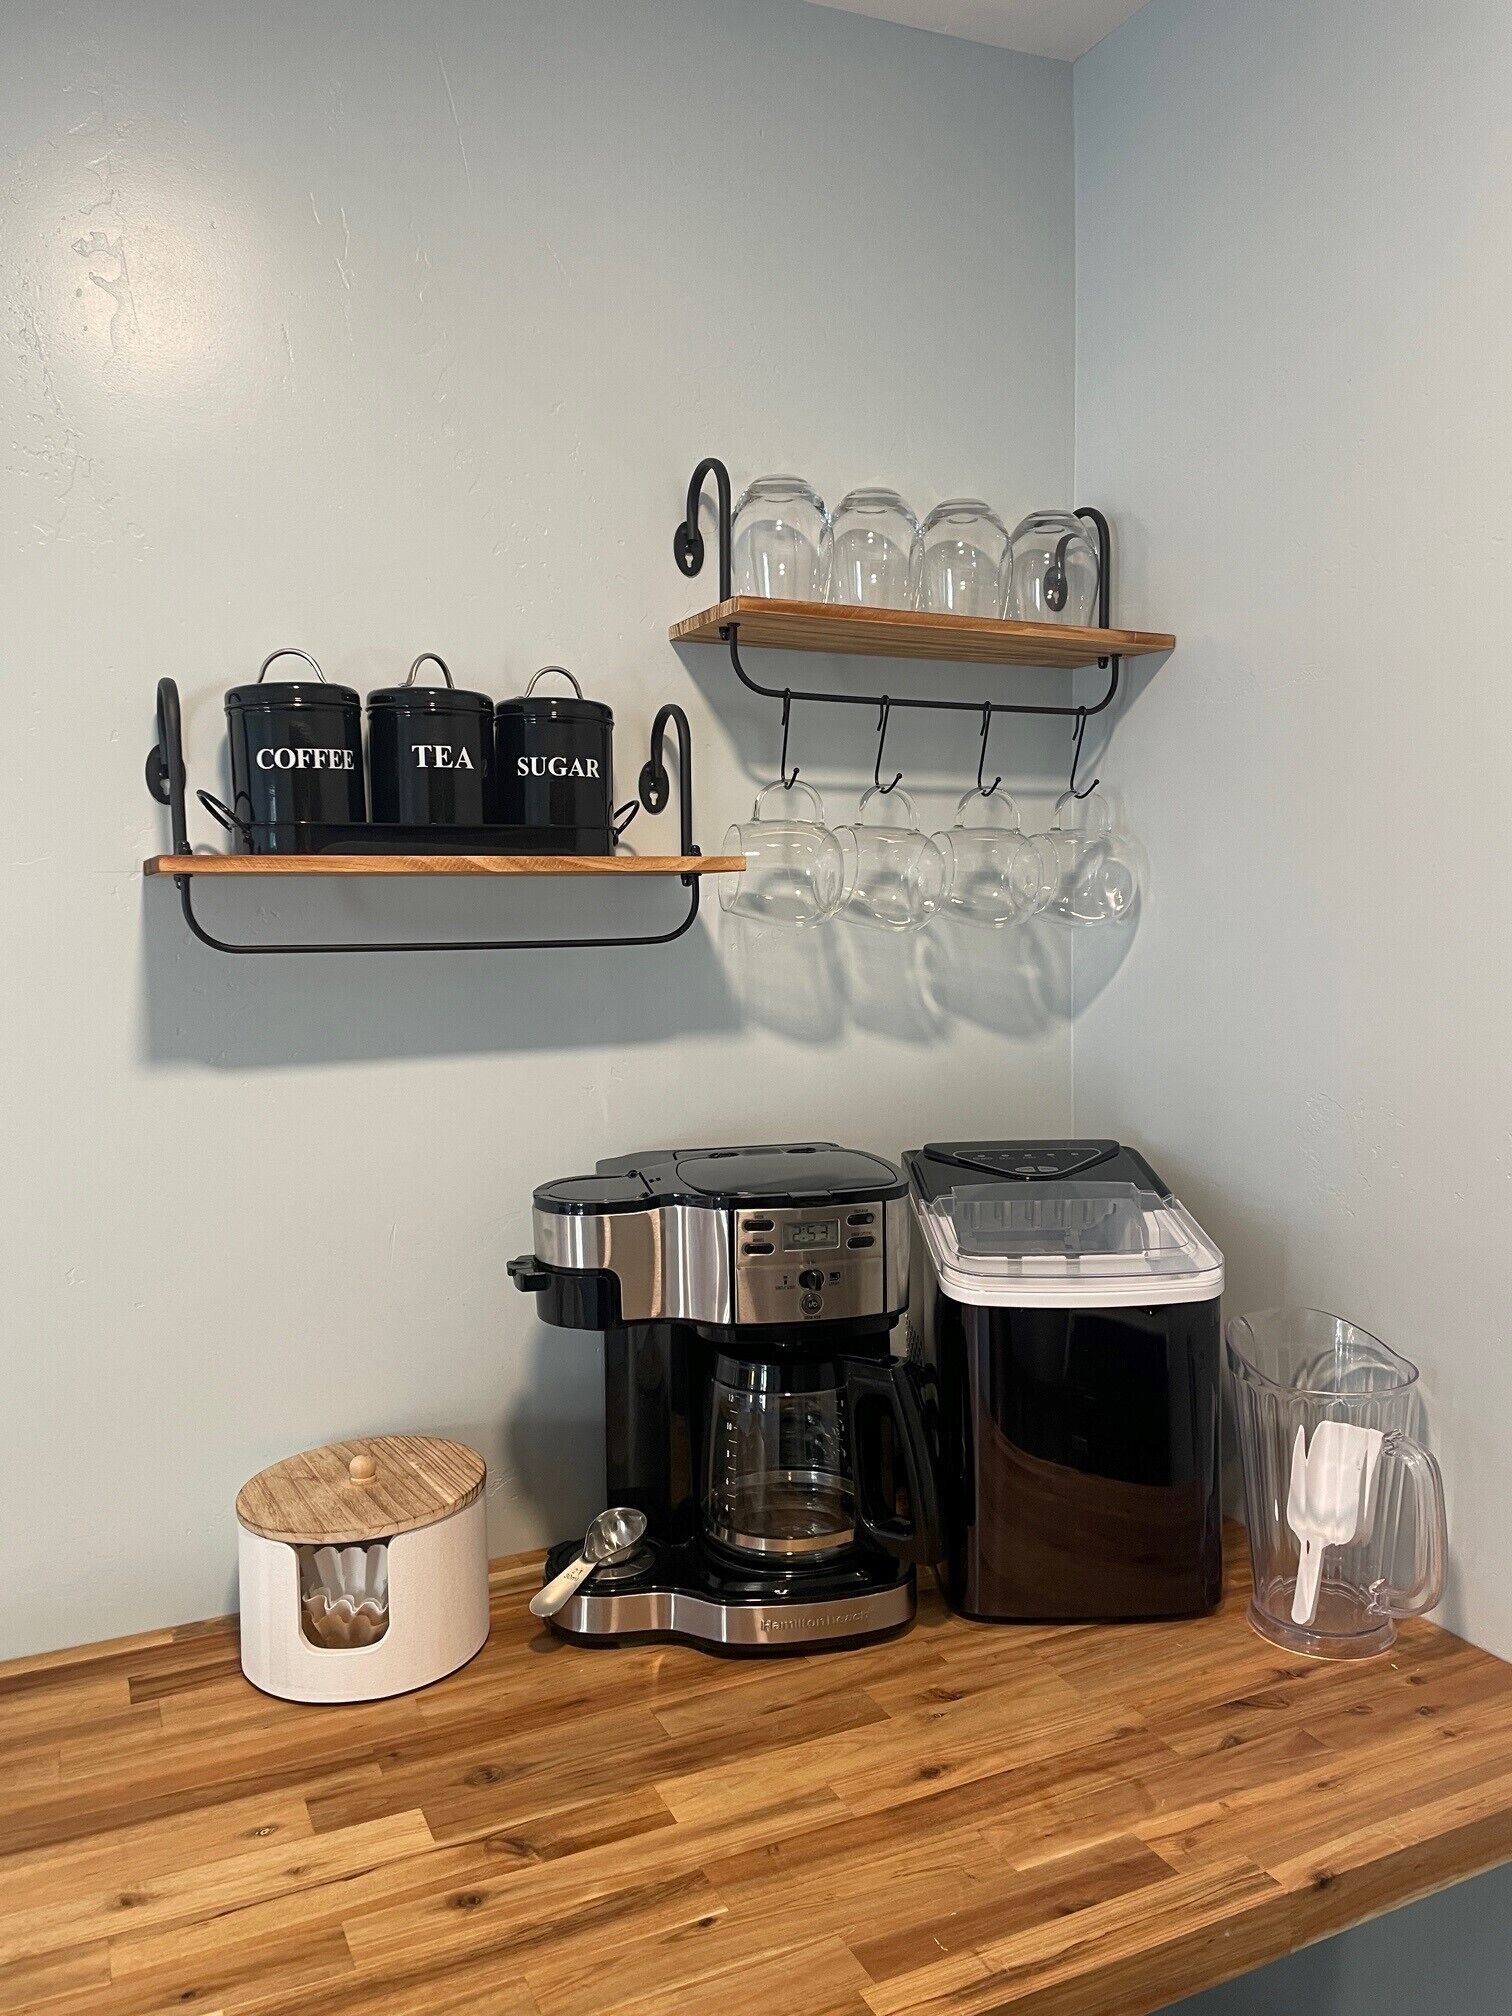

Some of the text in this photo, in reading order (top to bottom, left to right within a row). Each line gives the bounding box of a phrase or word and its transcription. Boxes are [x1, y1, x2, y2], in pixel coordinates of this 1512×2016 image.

[256, 748, 355, 770] COFFEE
[411, 745, 475, 770] TEA
[517, 756, 601, 779] SUGAR
